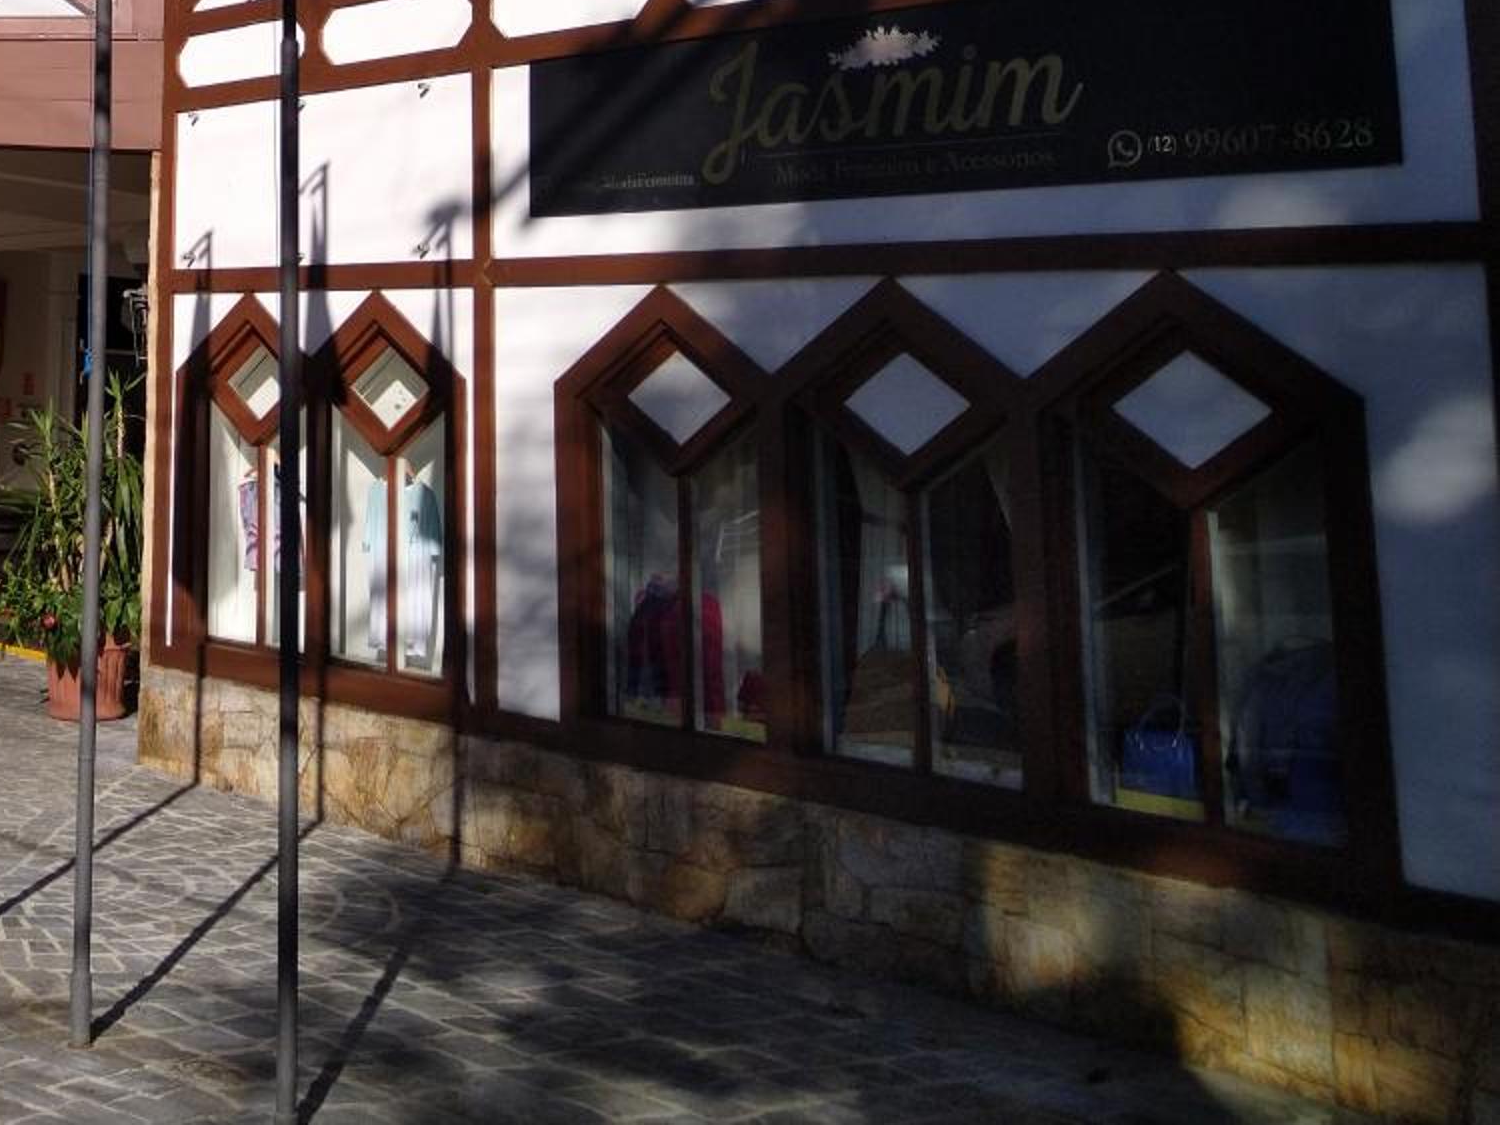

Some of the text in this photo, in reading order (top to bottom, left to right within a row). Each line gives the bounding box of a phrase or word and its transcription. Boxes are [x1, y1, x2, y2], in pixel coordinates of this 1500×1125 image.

[700, 41, 1083, 186] Jasmim
[1147, 118, 1374, 157] (12) 99607-8628
